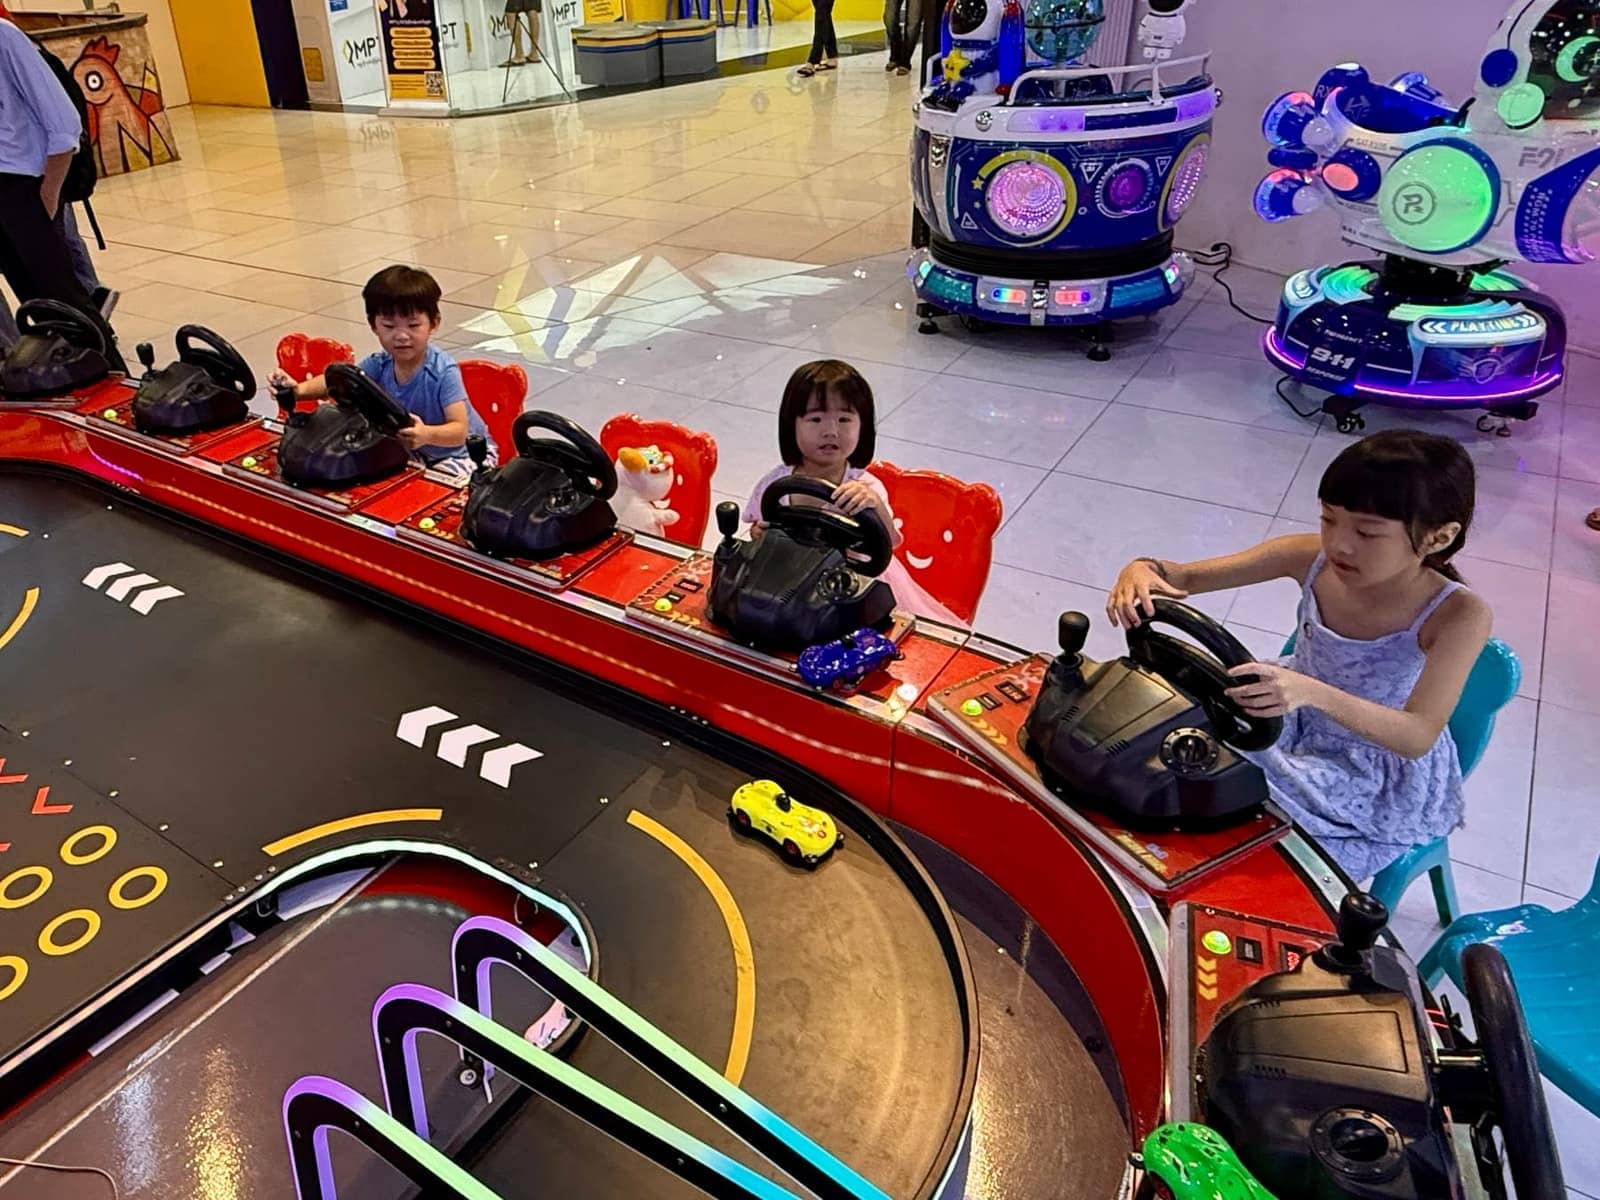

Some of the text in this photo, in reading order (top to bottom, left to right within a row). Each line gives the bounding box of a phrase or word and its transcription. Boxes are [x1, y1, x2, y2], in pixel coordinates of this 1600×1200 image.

[555, 2, 577, 21] MPT
[441, 22, 457, 40] PT
[353, 35, 379, 60] MP
